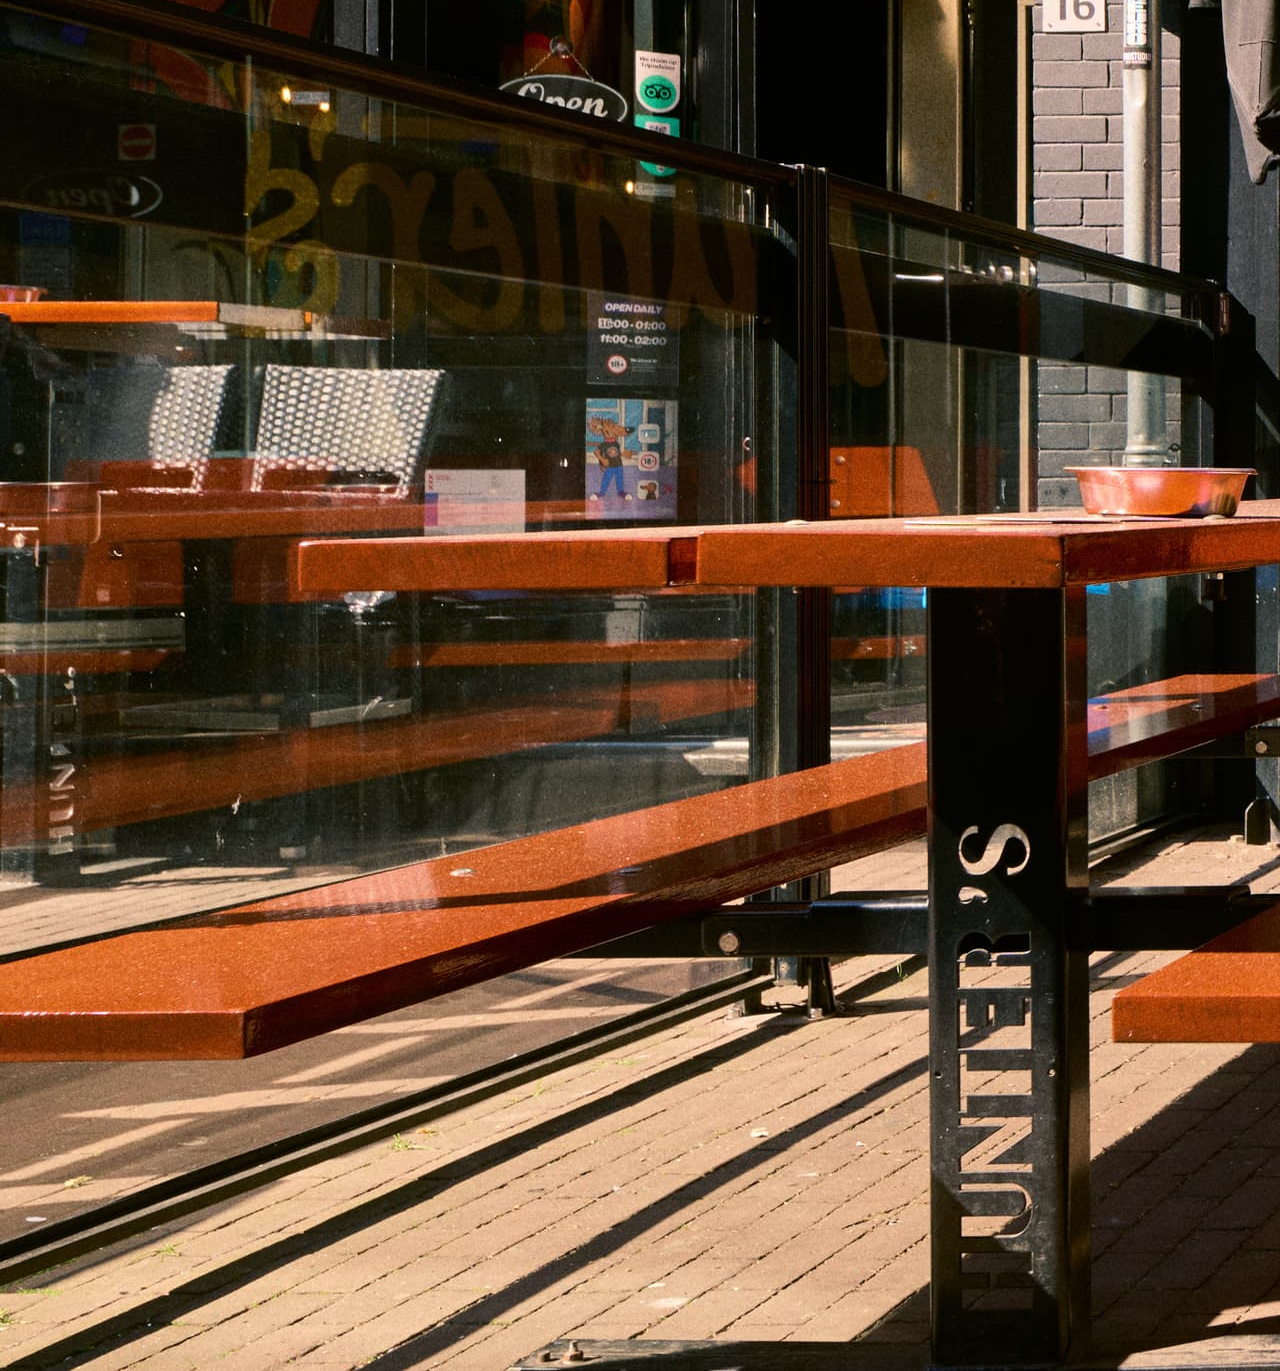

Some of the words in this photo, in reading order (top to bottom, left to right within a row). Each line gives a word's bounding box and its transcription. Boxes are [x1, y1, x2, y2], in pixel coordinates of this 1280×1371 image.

[605, 302, 633, 312] OPEN
[634, 304, 662, 314] DAILY
[635, 320, 666, 330] 01:00
[634, 335, 668, 346] 02:00
[957, 822, 1034, 1311] HUNTER'S
